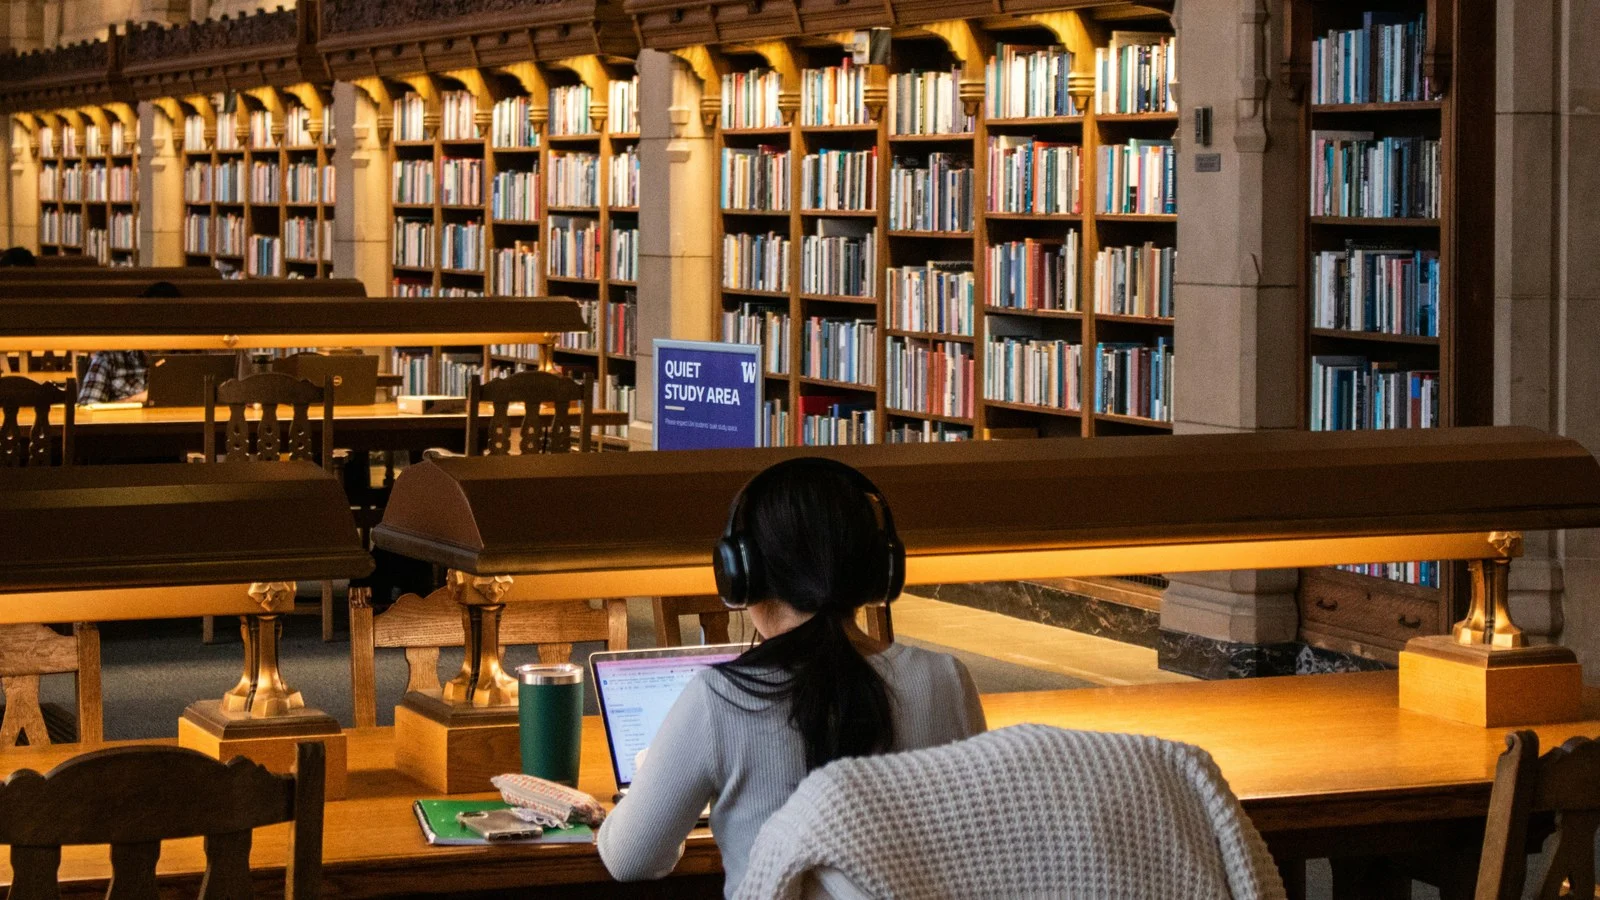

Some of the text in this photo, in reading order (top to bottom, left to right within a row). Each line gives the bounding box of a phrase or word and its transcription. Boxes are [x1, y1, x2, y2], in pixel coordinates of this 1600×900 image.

[665, 360, 701, 379] QUIET
[741, 362, 756, 384] W
[665, 384, 740, 406] STUDY AREA
